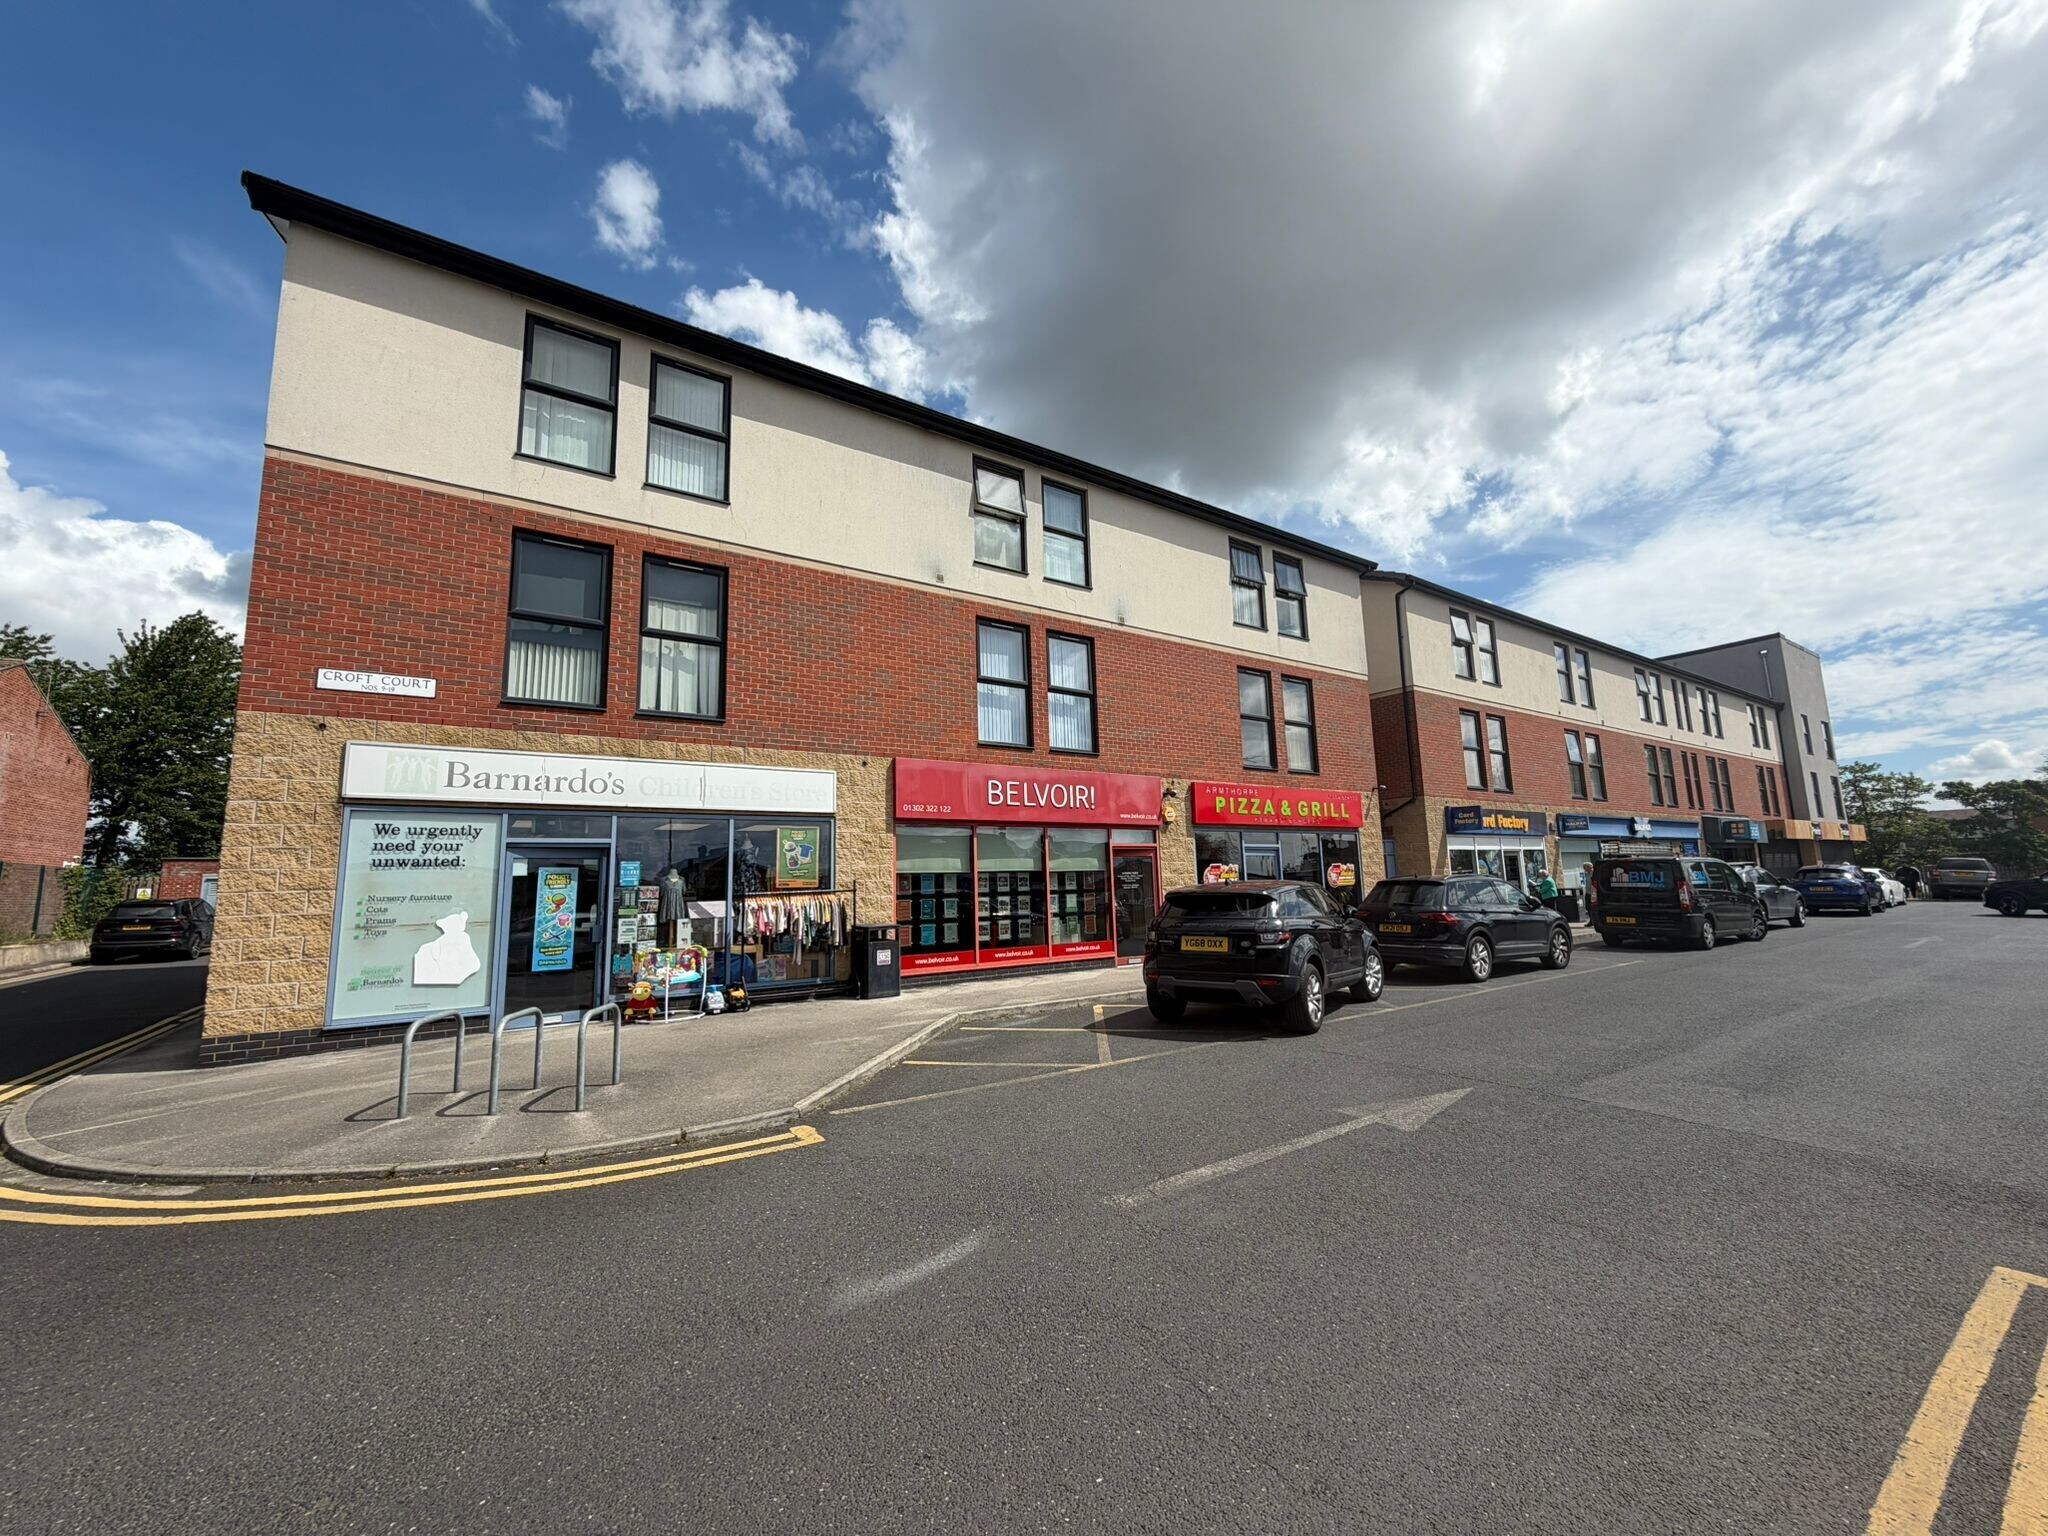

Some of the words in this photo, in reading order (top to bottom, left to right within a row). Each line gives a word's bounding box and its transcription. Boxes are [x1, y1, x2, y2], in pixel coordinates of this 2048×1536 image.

[323, 671, 374, 684] CROFT
[381, 676, 431, 689] COURT
[443, 760, 625, 796] Barnardo's
[987, 779, 1096, 810] BELVOIR!
[1205, 786, 1259, 797] ARMTHORPE
[903, 804, 925, 812] 01302
[925, 804, 938, 813] 322
[939, 805, 952, 813] 122
[1215, 796, 1276, 816] PIZZA
[1280, 799, 1292, 817] &
[1297, 800, 1350, 819] GRILL
[1497, 814, 1529, 832] Factory
[374, 823, 401, 836] We
[407, 824, 483, 840] urgently
[371, 840, 416, 852] need
[421, 842, 464, 855] your
[371, 855, 466, 868] unwanted:
[1629, 871, 1665, 883] BMJ
[367, 894, 407, 903] Nursery
[409, 893, 453, 901] furniture
[366, 905, 389, 913] Cots
[365, 917, 397, 925] Prams
[364, 928, 388, 937] Toys
[1065, 944, 1101, 952] www.belvoir.co.uk
[1184, 938, 1206, 948] YG68
[1207, 939, 1224, 948] OXX
[994, 949, 1034, 958] www.belvoir.co.uk
[915, 956, 959, 965] www.belvoir.co.uk
